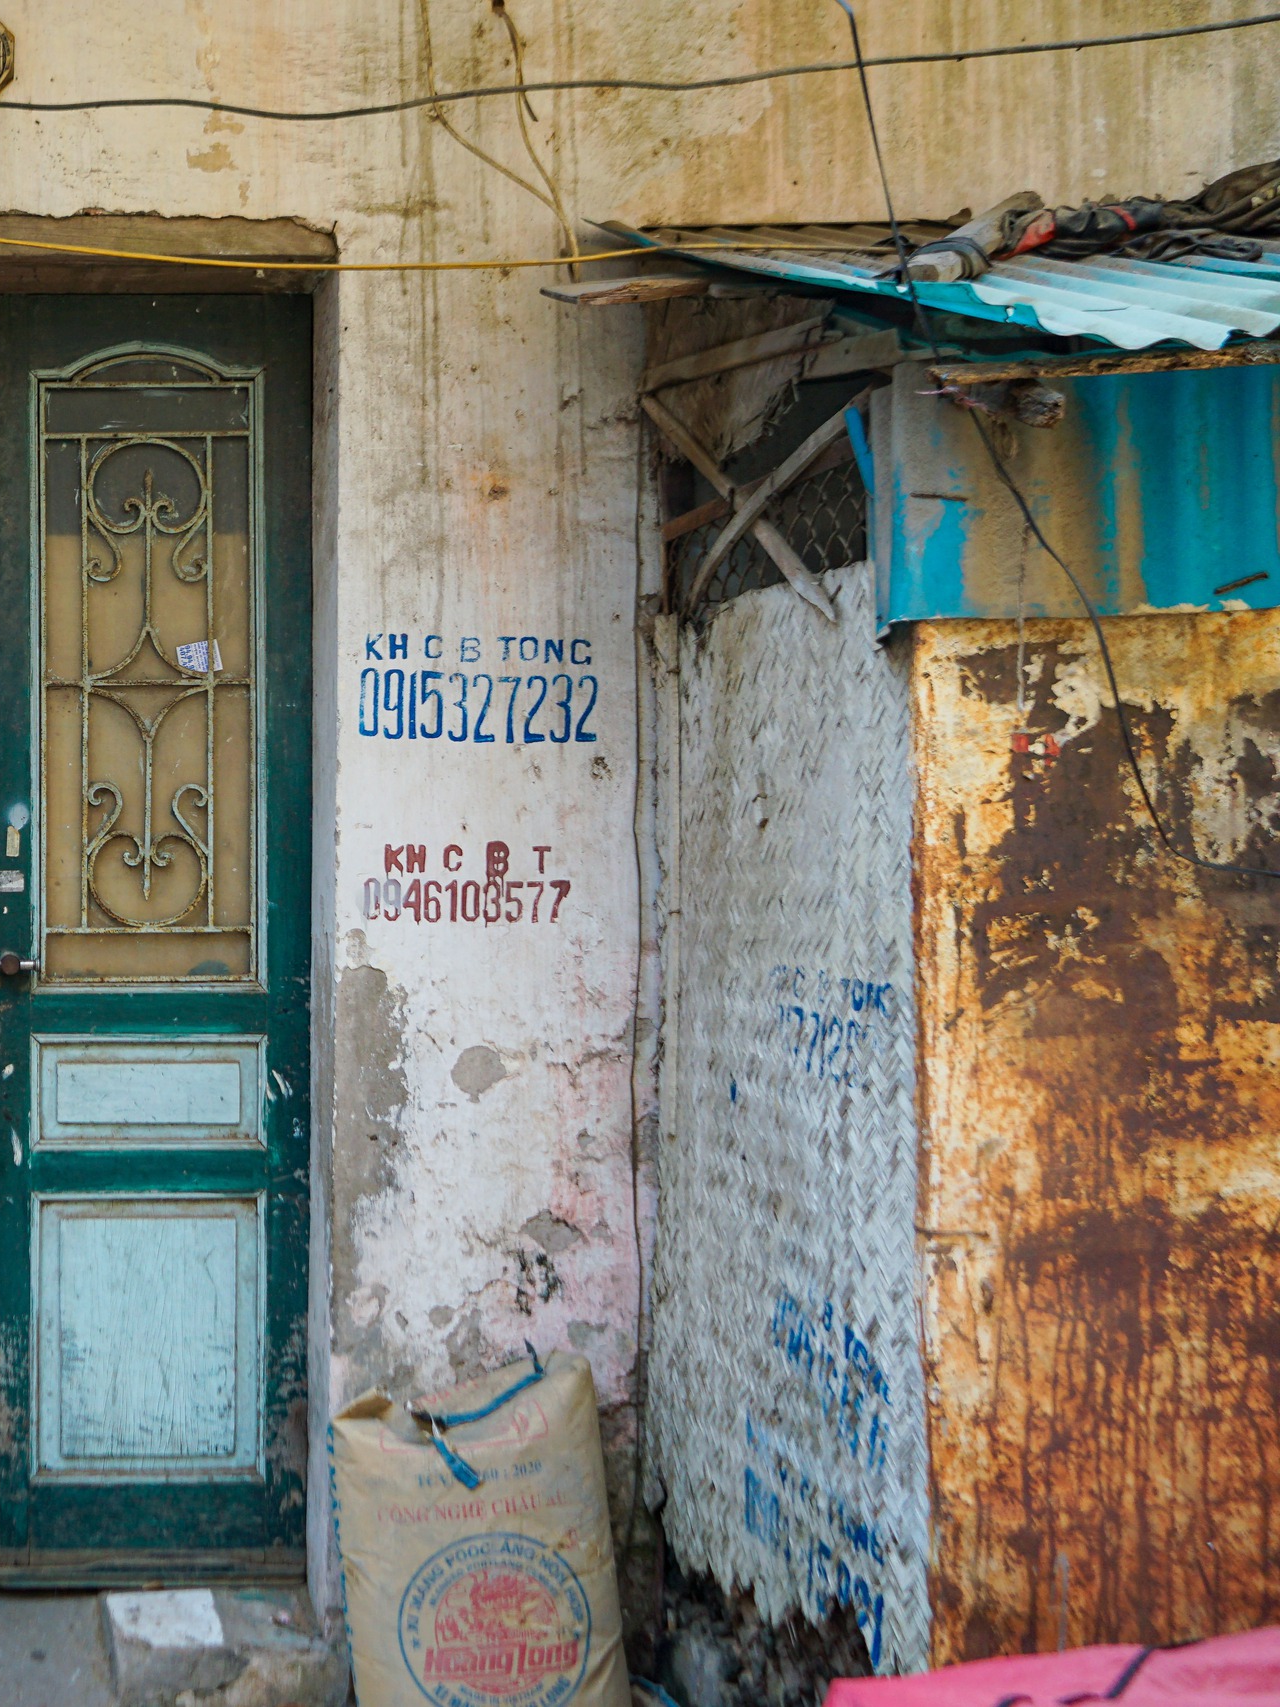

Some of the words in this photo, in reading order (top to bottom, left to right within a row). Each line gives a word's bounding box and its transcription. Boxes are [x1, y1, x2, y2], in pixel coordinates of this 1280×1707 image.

[365, 633, 409, 661] KH
[424, 634, 443, 660] C
[460, 637, 482, 663] B
[497, 636, 592, 665] TONG
[358, 667, 599, 744] 0915327232
[384, 844, 427, 873] KH
[443, 844, 463, 872] C
[486, 841, 510, 878] B
[532, 846, 552, 874] T
[363, 877, 571, 924] 0946103577
